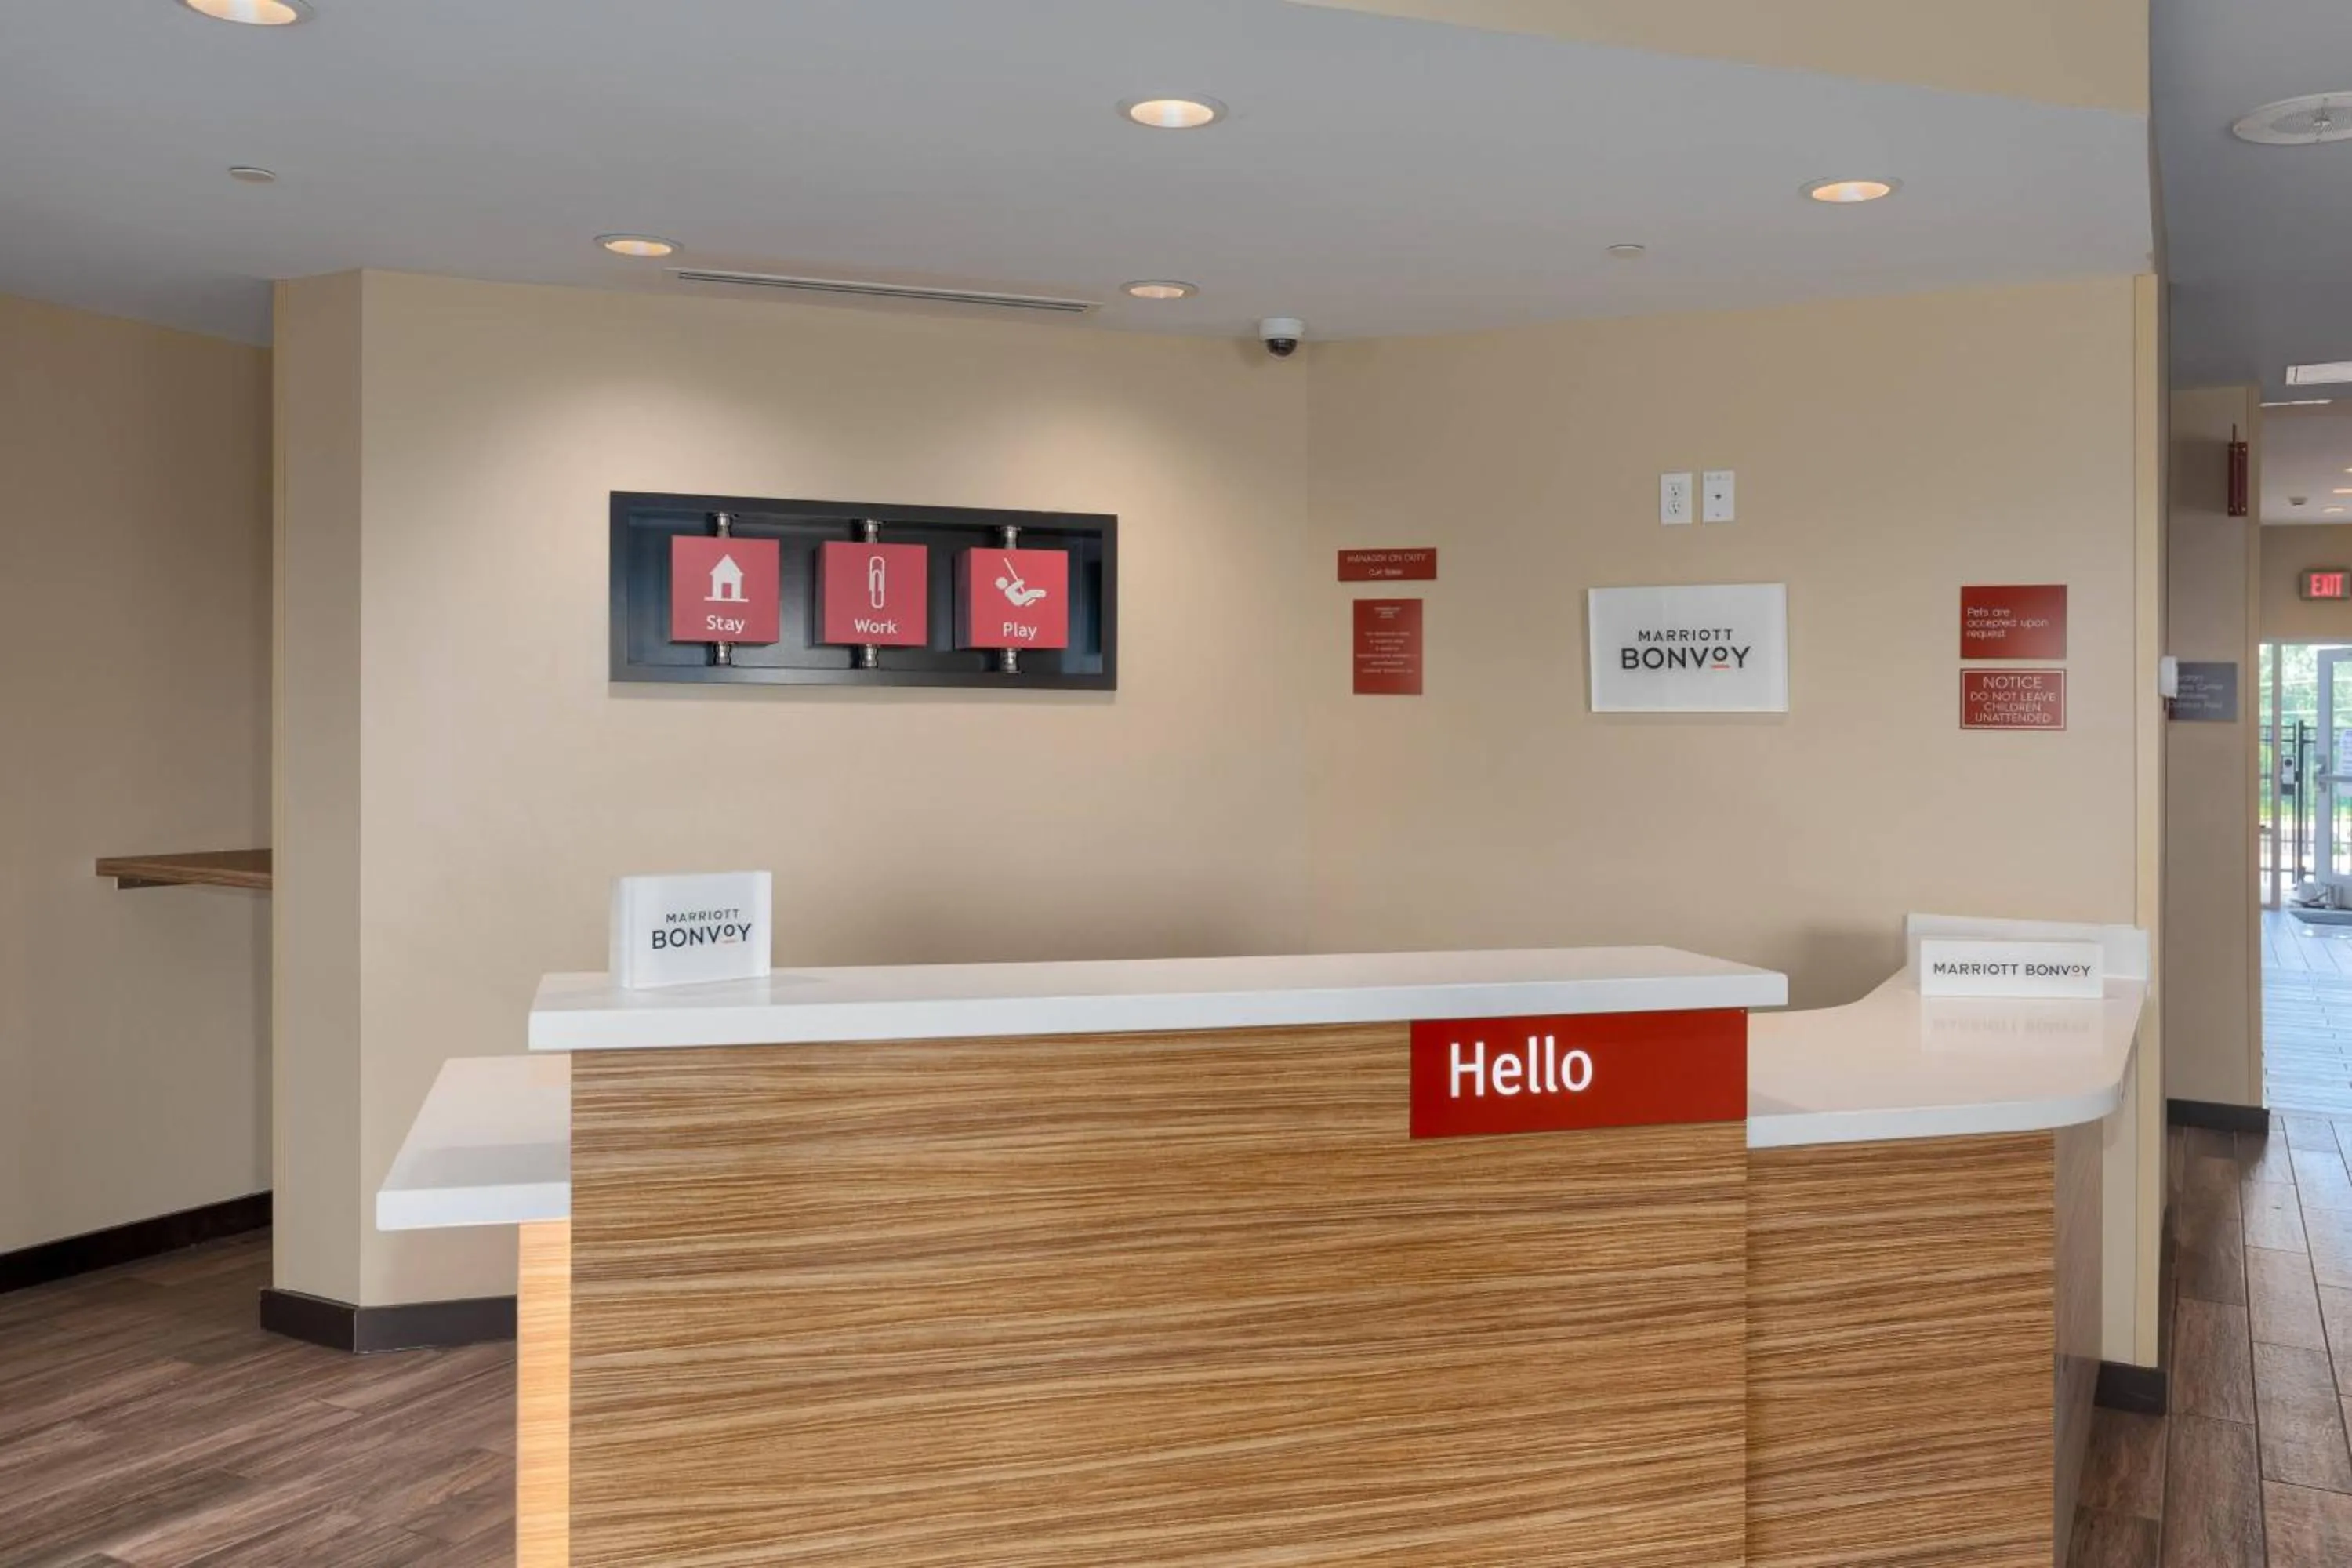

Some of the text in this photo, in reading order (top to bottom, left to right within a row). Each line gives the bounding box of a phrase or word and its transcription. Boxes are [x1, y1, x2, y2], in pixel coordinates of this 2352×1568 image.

[1404, 553, 1426, 563] DUTY
[2310, 573, 2343, 597] EXIT
[1967, 607, 1989, 616] Pets
[706, 615, 745, 634] Stay
[855, 619, 897, 635] Work
[1967, 618, 2048, 629] accepted upon
[1003, 622, 1037, 640] Play
[1638, 629, 1733, 642] MARRIOTT
[1621, 646, 1751, 670] BONVOY
[1983, 677, 2042, 688] NOTICE
[1970, 691, 2056, 702] DO NOT LEAVE
[1984, 702, 2042, 712] CHILDREN
[1976, 713, 2051, 723] UNATTENDED
[666, 909, 740, 923] MARRIOTT
[652, 923, 752, 949] BONVOY
[1933, 963, 2092, 976] MARRIOTT BONVOY
[1450, 1035, 1592, 1098] Hello
